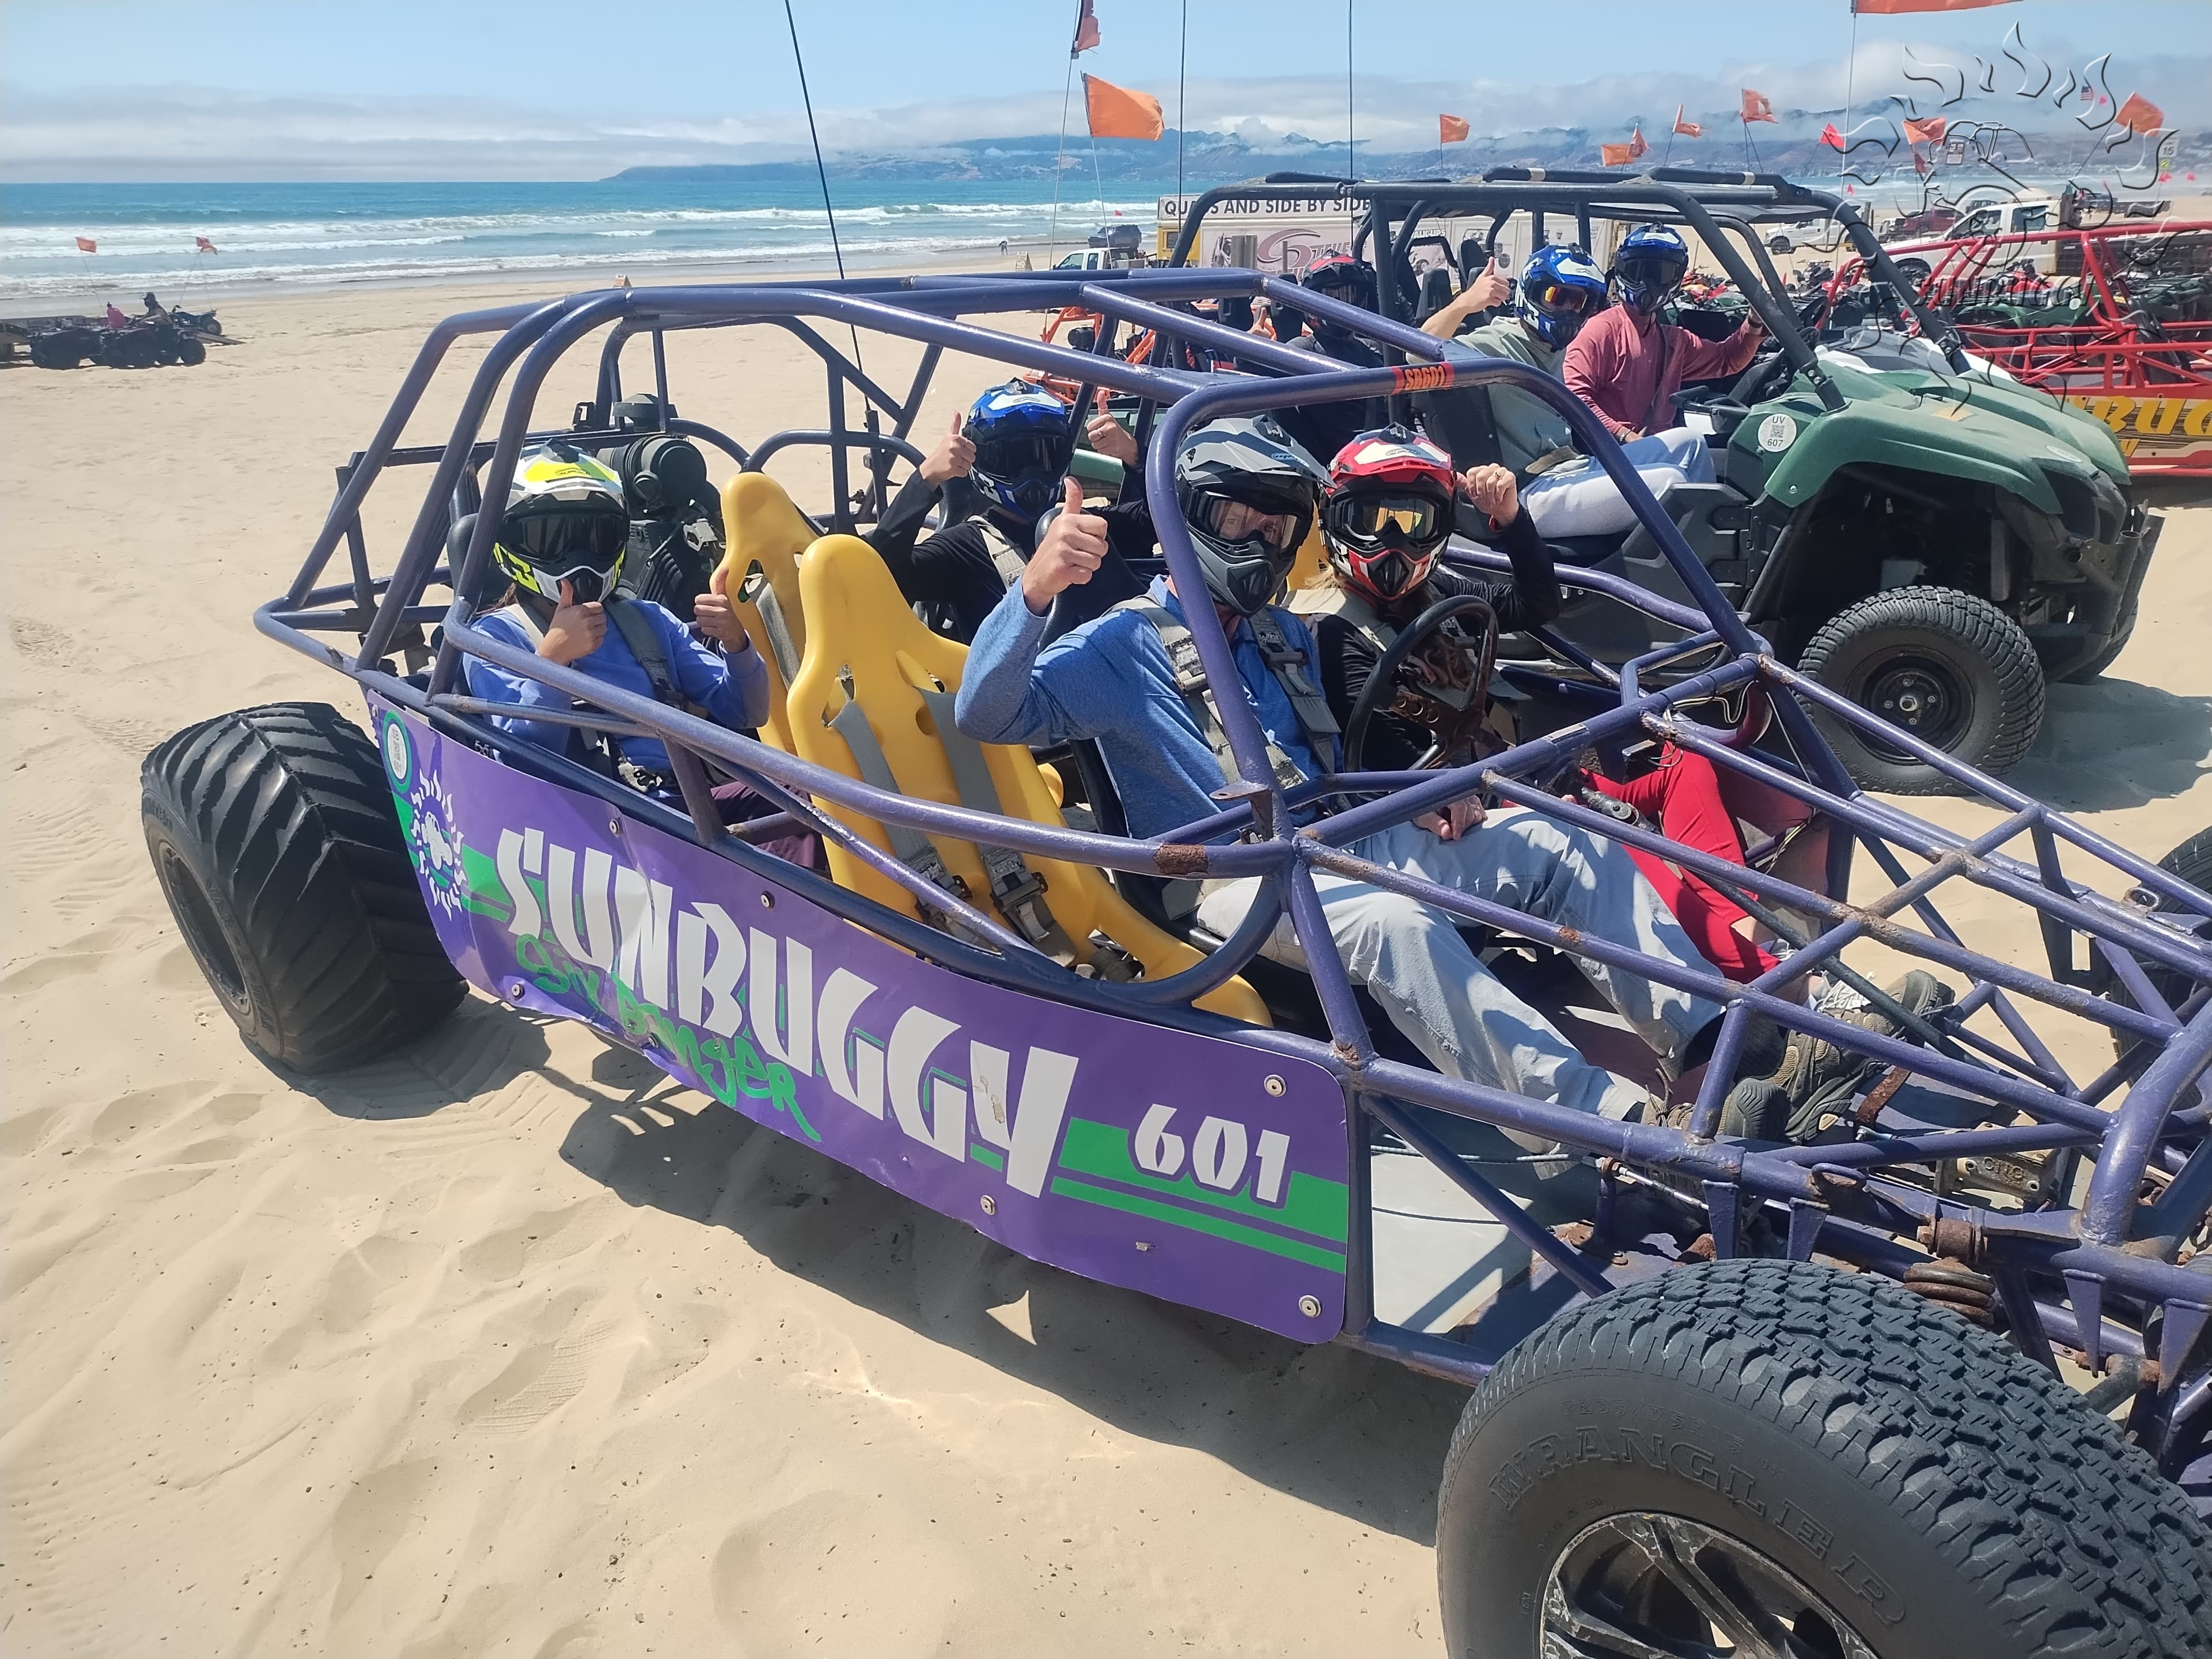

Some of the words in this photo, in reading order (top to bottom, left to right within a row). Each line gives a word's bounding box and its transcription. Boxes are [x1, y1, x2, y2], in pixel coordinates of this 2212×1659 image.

[1165, 200, 1218, 215] QUS
[1224, 199, 1260, 214] AND
[1266, 199, 1301, 213] SIDE
[1307, 199, 1326, 213] BY
[1333, 199, 1370, 211] SIDE
[1411, 229, 1446, 238] ALK-UPS
[1404, 365, 1445, 391] SB601
[1772, 416, 1785, 424] UV
[1767, 438, 1784, 447] 607
[497, 827, 1078, 1198] SUNBUGGY
[1134, 1104, 1290, 1203] 601
[1488, 1426, 1906, 1627] WRANGLER
